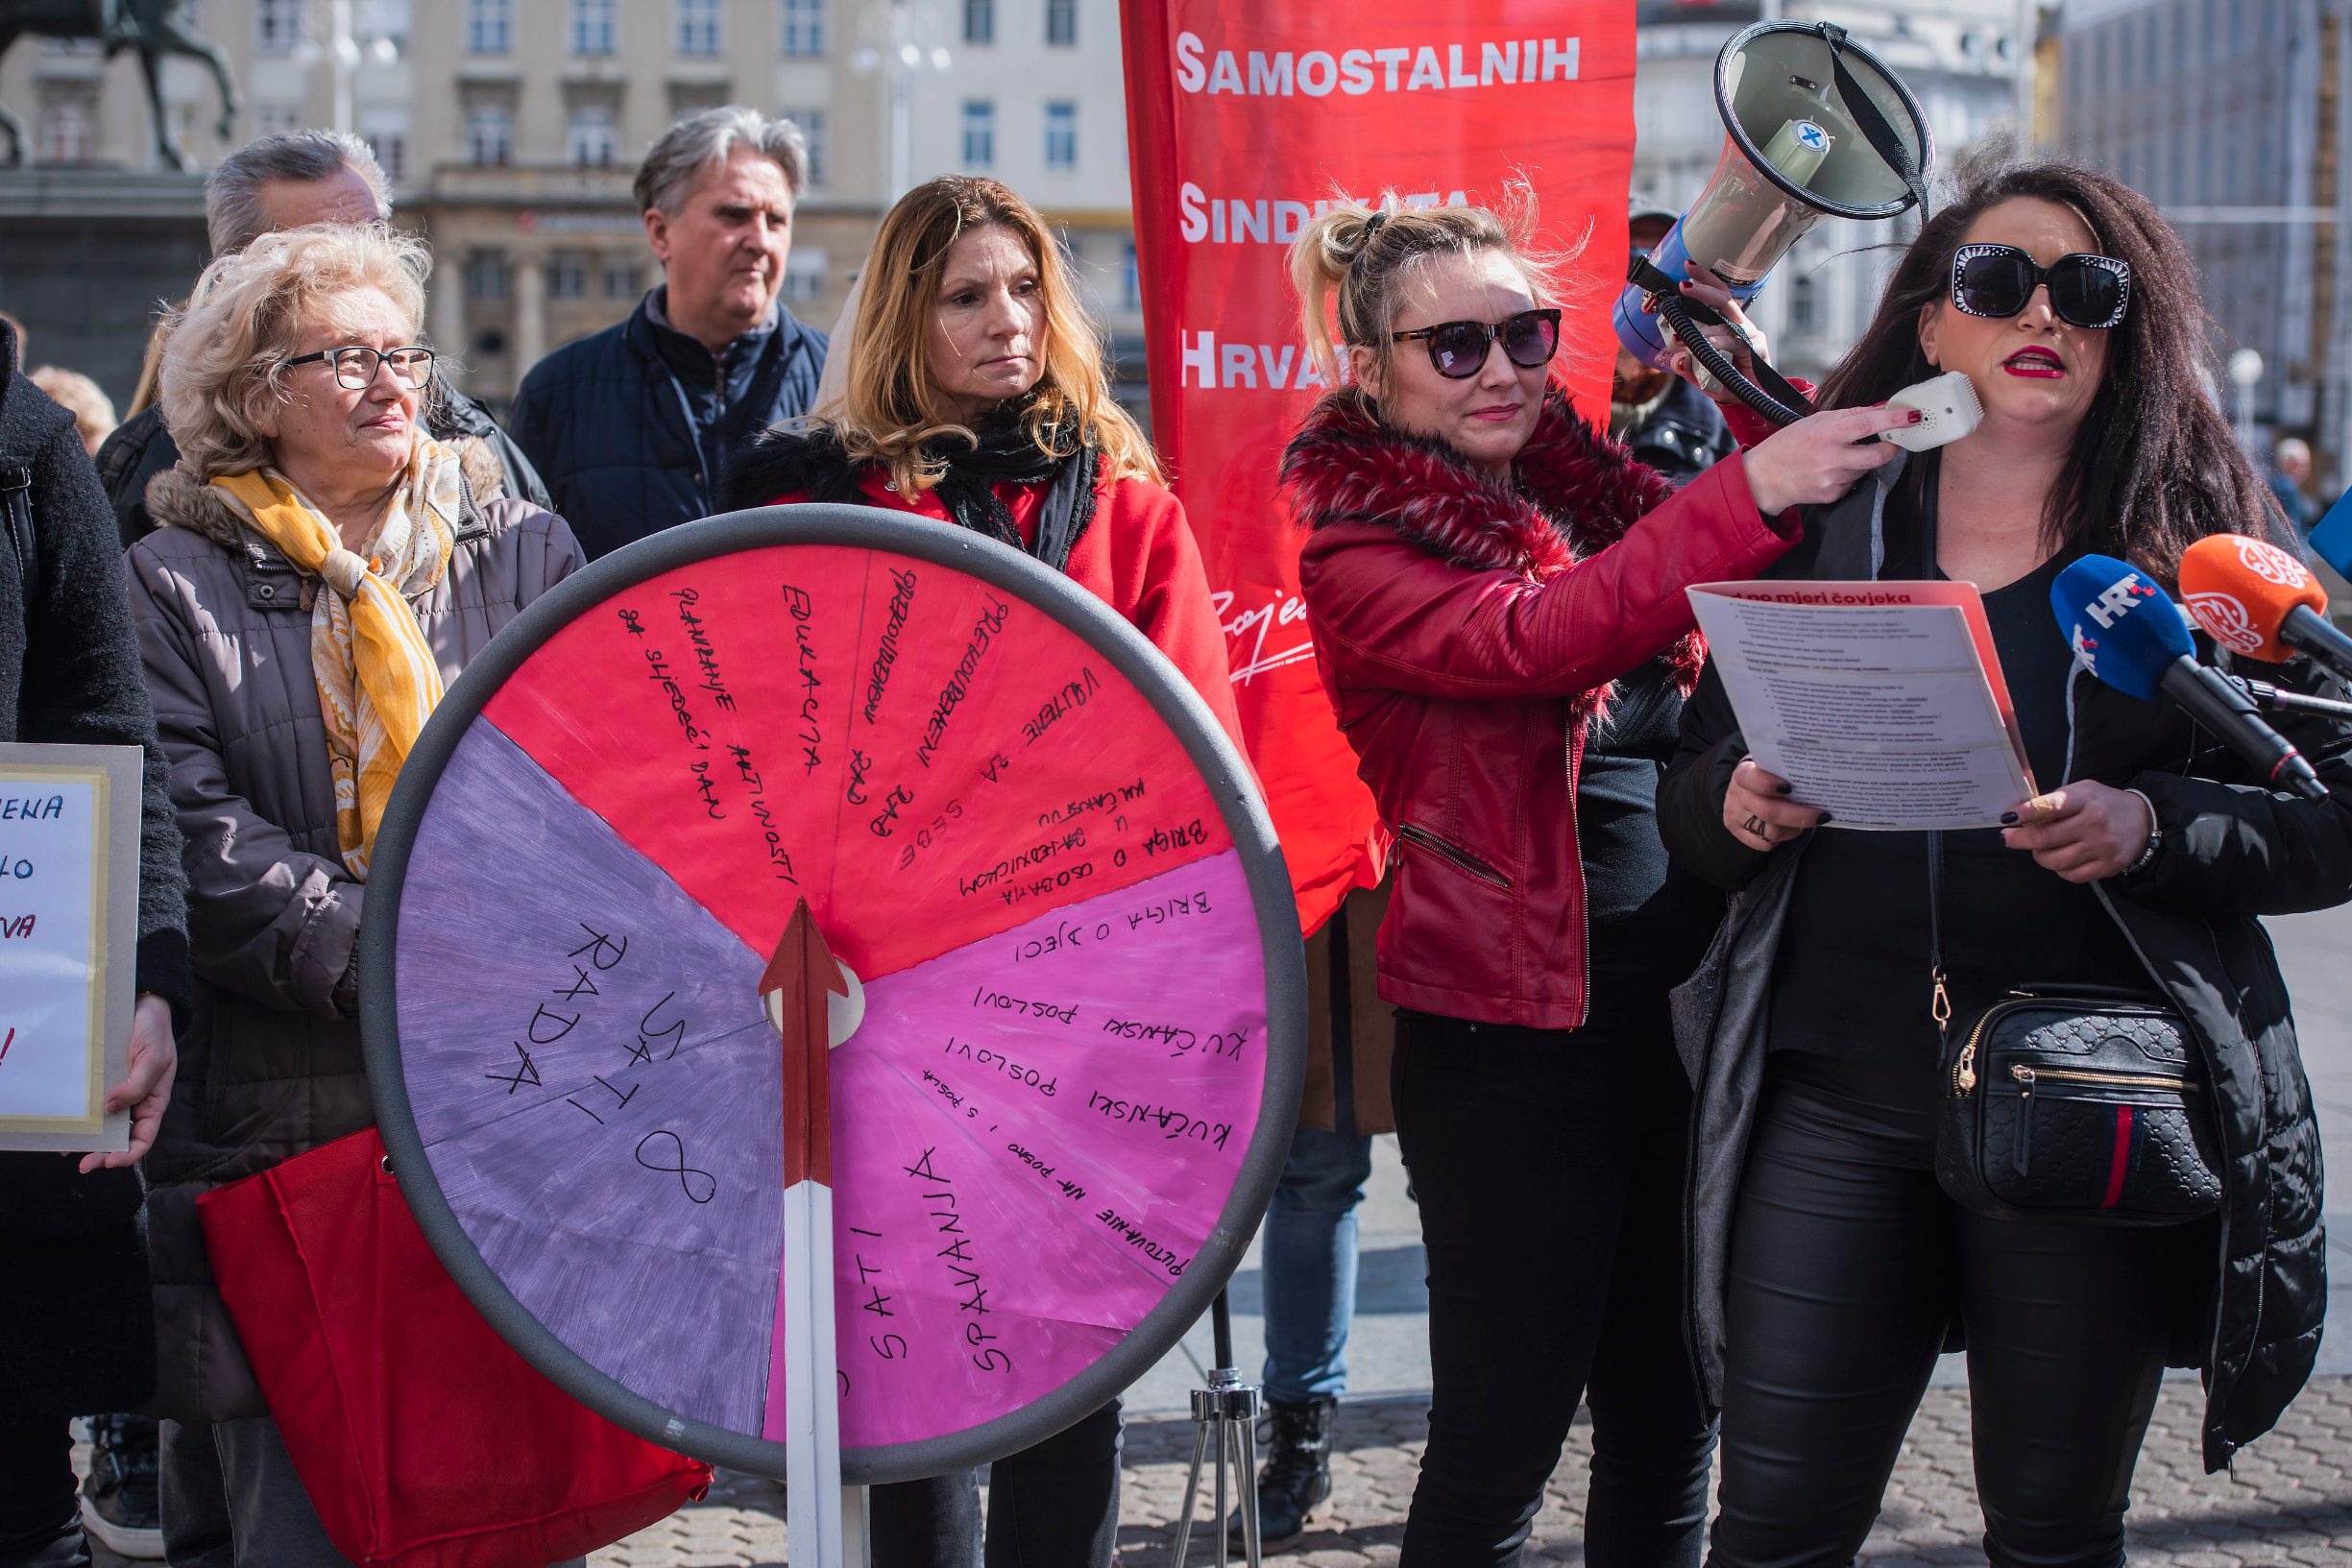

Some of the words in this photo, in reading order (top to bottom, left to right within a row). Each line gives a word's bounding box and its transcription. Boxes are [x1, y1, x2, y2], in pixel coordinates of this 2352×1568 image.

[1176, 32, 1580, 97] SAMOSTALNIH
[1831, 591, 1912, 606] čovjeka
[2085, 573, 2141, 629] HRT
[691, 761, 725, 819] DAN
[727, 745, 798, 884] AKTIVNOSTI
[868, 784, 915, 838] RAD
[899, 800, 962, 870] SEBE
[1113, 848, 1128, 868] O
[1143, 819, 1207, 856] BRIGA
[1003, 863, 1092, 905] OSOBAMA
[1128, 892, 1211, 929] BRIGA
[1016, 922, 1081, 961] DJECI
[1095, 922, 1111, 941] O
[485, 923, 627, 1095] RADA
[975, 987, 1078, 1024] POSLOVI
[566, 992, 685, 1124] SATI
[946, 1037, 1056, 1097] POSLOVI
[923, 1071, 963, 1108] POSLA
[1089, 1091, 1231, 1151] KUĆANSKI
[636, 1130, 716, 1203] 8
[1008, 1145, 1055, 1178] POSAO
[1056, 1180, 1085, 1200] NA
[903, 1147, 1009, 1373] SPAVANJA
[1097, 1210, 1190, 1278] PUTOVANJE
[850, 1227, 907, 1359] SATI
